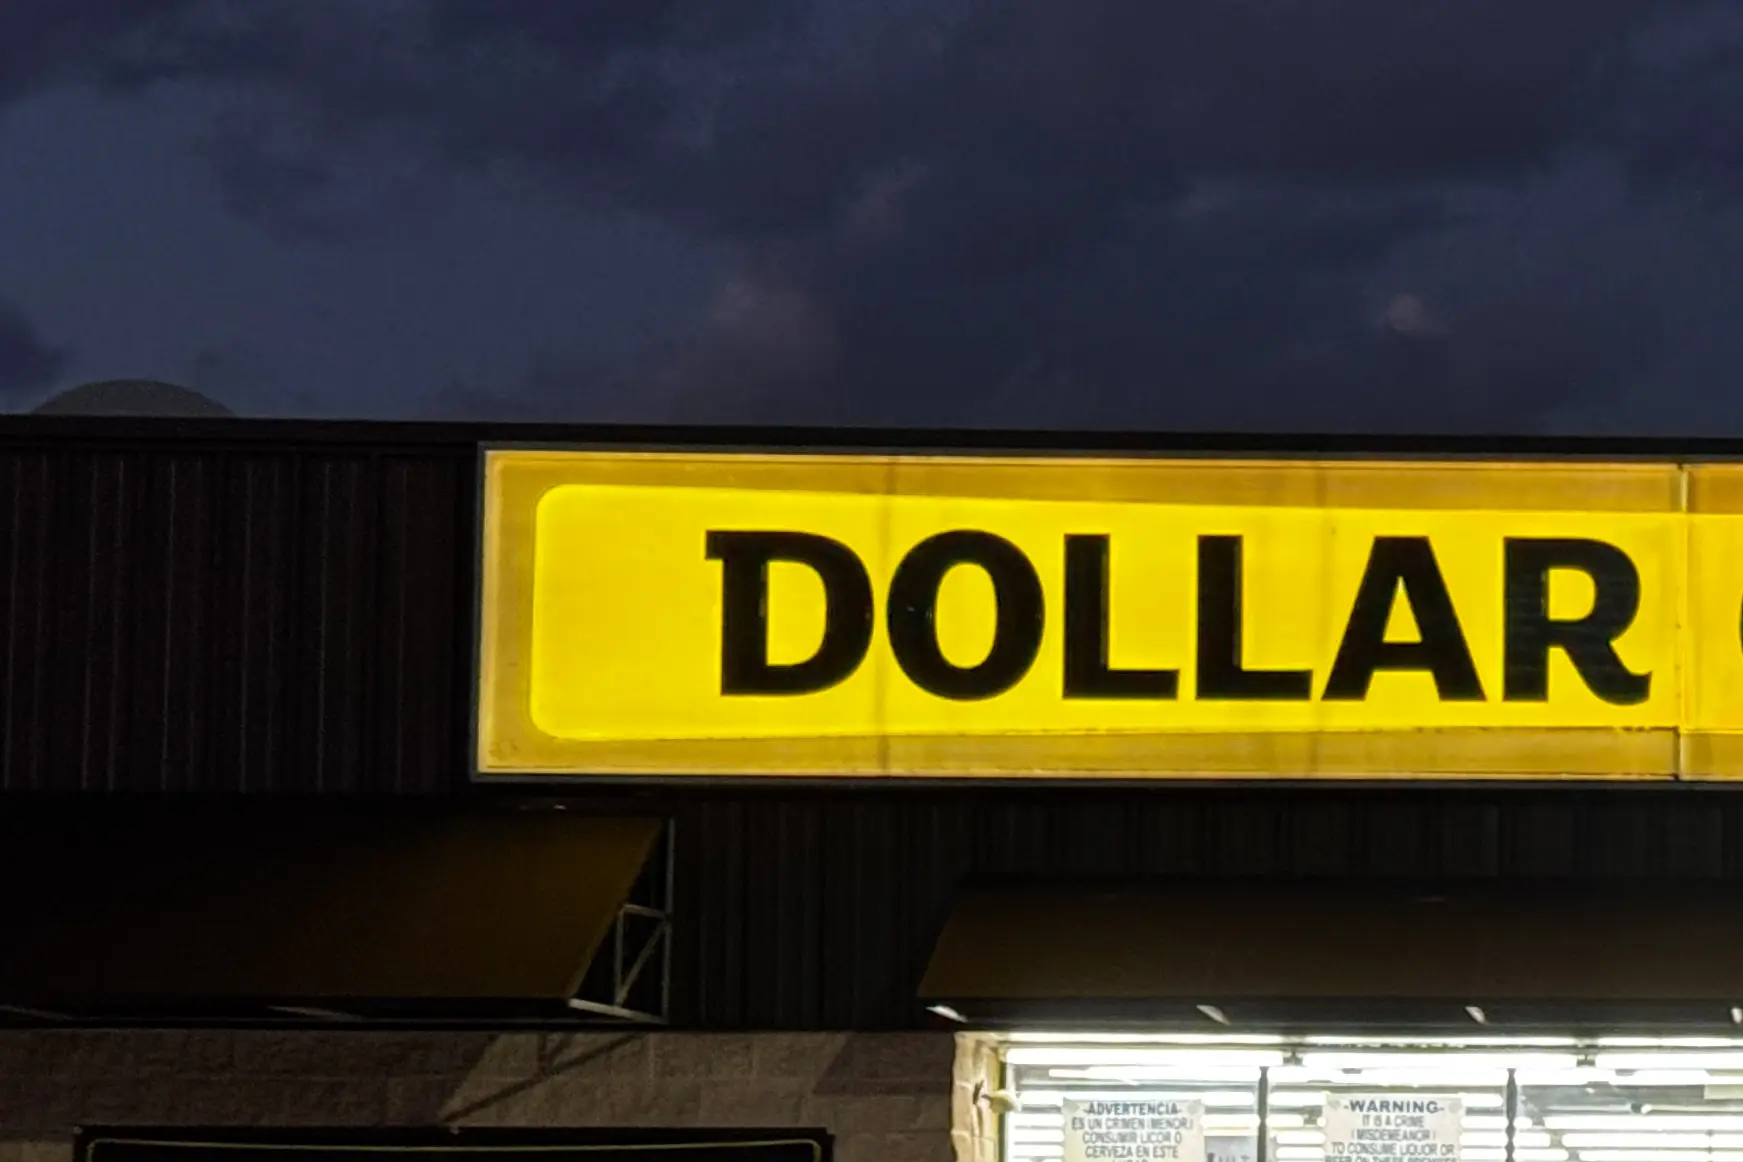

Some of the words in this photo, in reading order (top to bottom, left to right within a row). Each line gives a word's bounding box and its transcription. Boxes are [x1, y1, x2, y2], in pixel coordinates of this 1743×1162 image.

[704, 528, 1652, 706] DOLLAR
[1394, 1115, 1425, 1127] CRIME
[1085, 1146, 1133, 1158] CERVEZA
[1136, 1146, 1149, 1158] EN
[1332, 1142, 1345, 1155] TO
